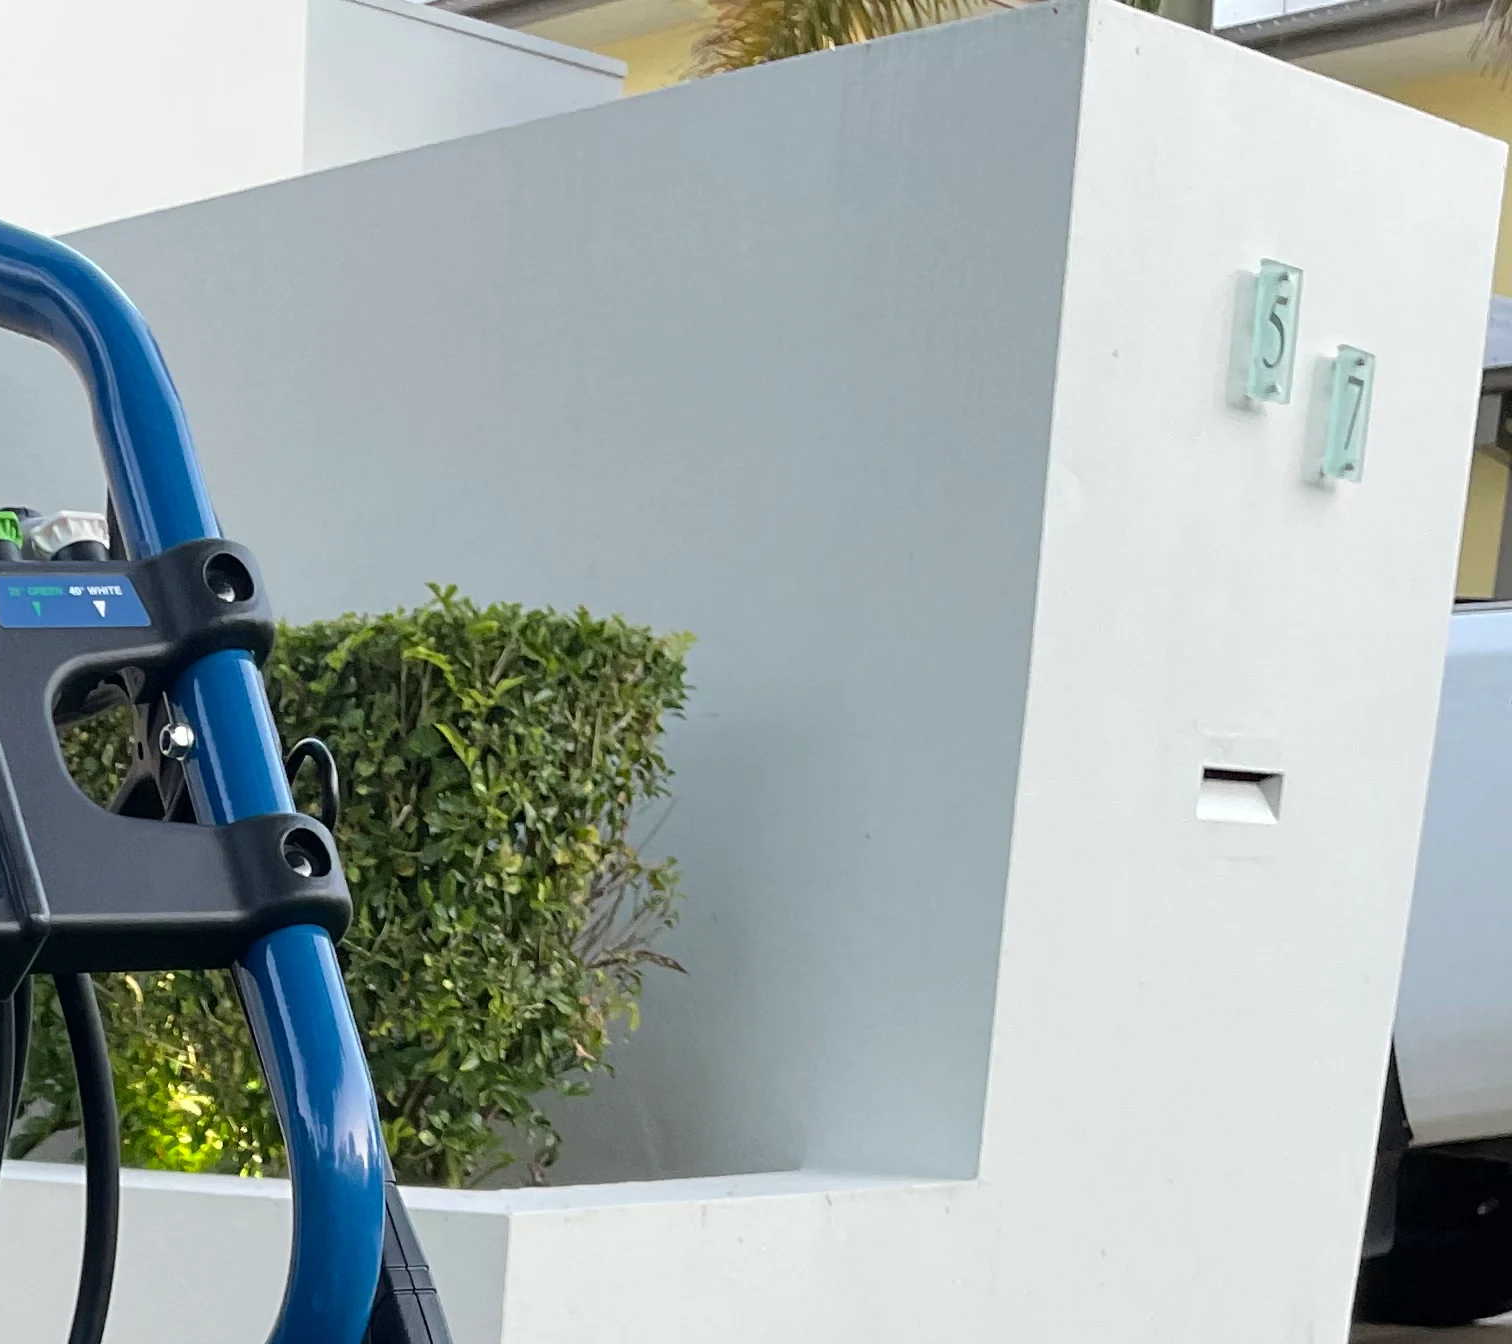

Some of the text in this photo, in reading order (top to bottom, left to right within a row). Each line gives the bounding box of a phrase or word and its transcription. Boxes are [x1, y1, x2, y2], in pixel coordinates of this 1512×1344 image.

[1262, 295, 1365, 450] 5 7
[26, 585, 64, 597] GREEN
[86, 585, 124, 596] WHITE
